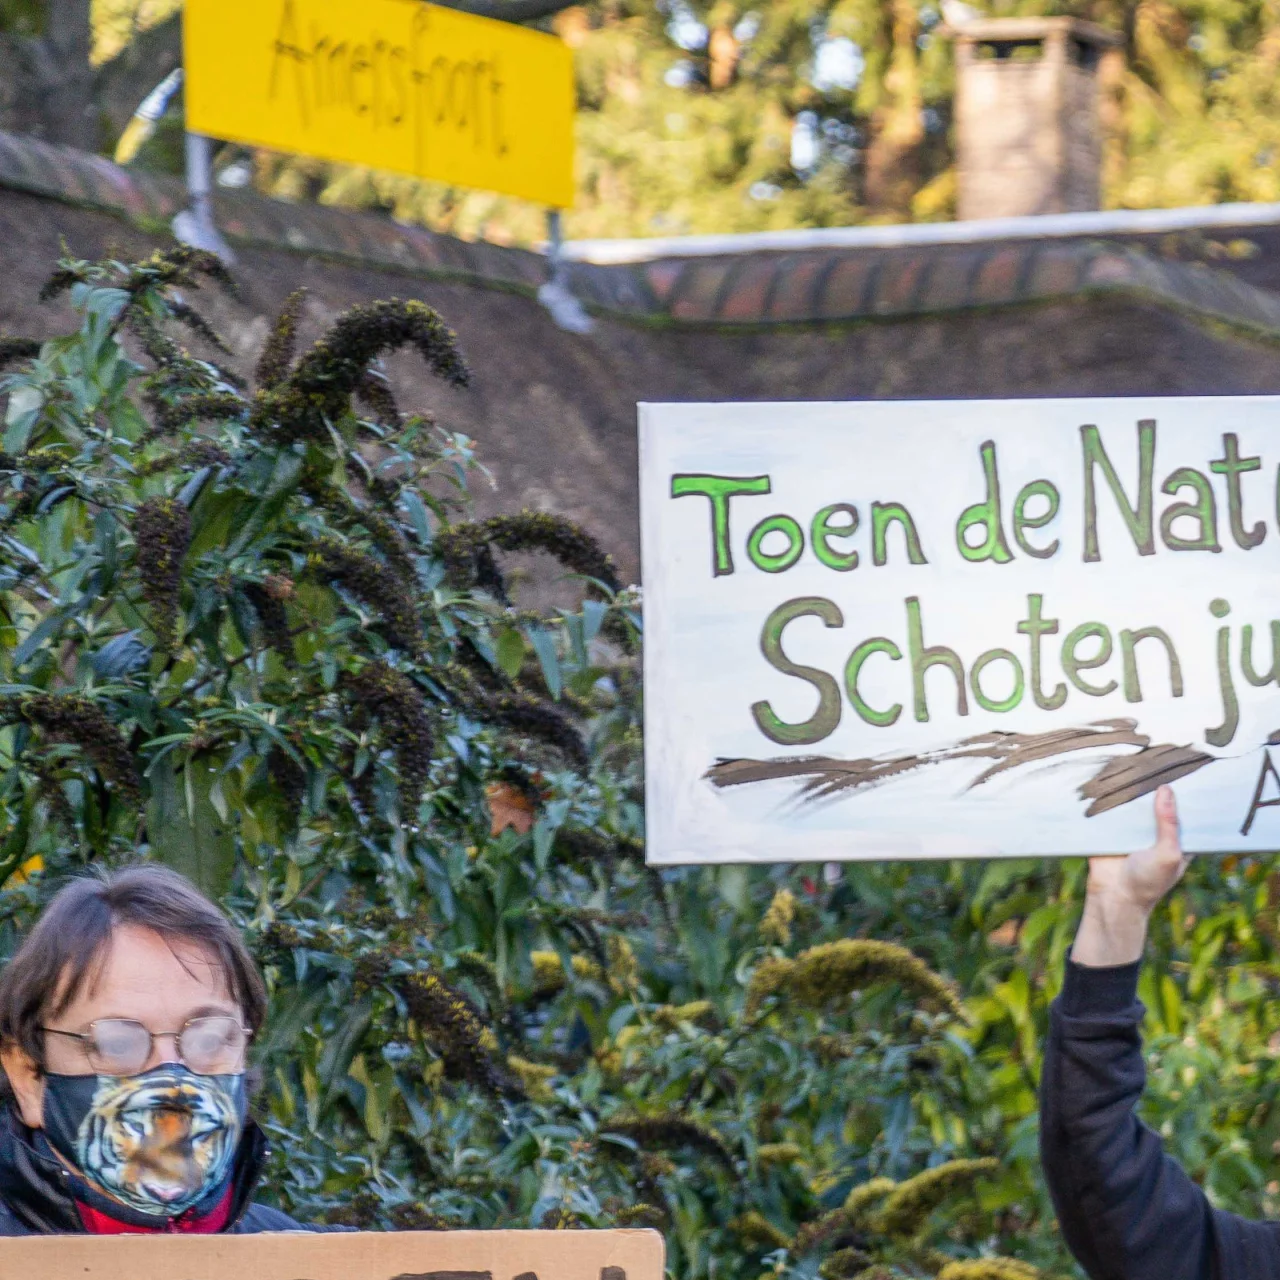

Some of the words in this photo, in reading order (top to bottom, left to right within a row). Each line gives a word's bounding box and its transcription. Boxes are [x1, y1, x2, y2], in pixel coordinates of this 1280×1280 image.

[671, 472, 929, 577] Toen
[956, 439, 1061, 564] de
[751, 593, 1183, 746] Schoten
